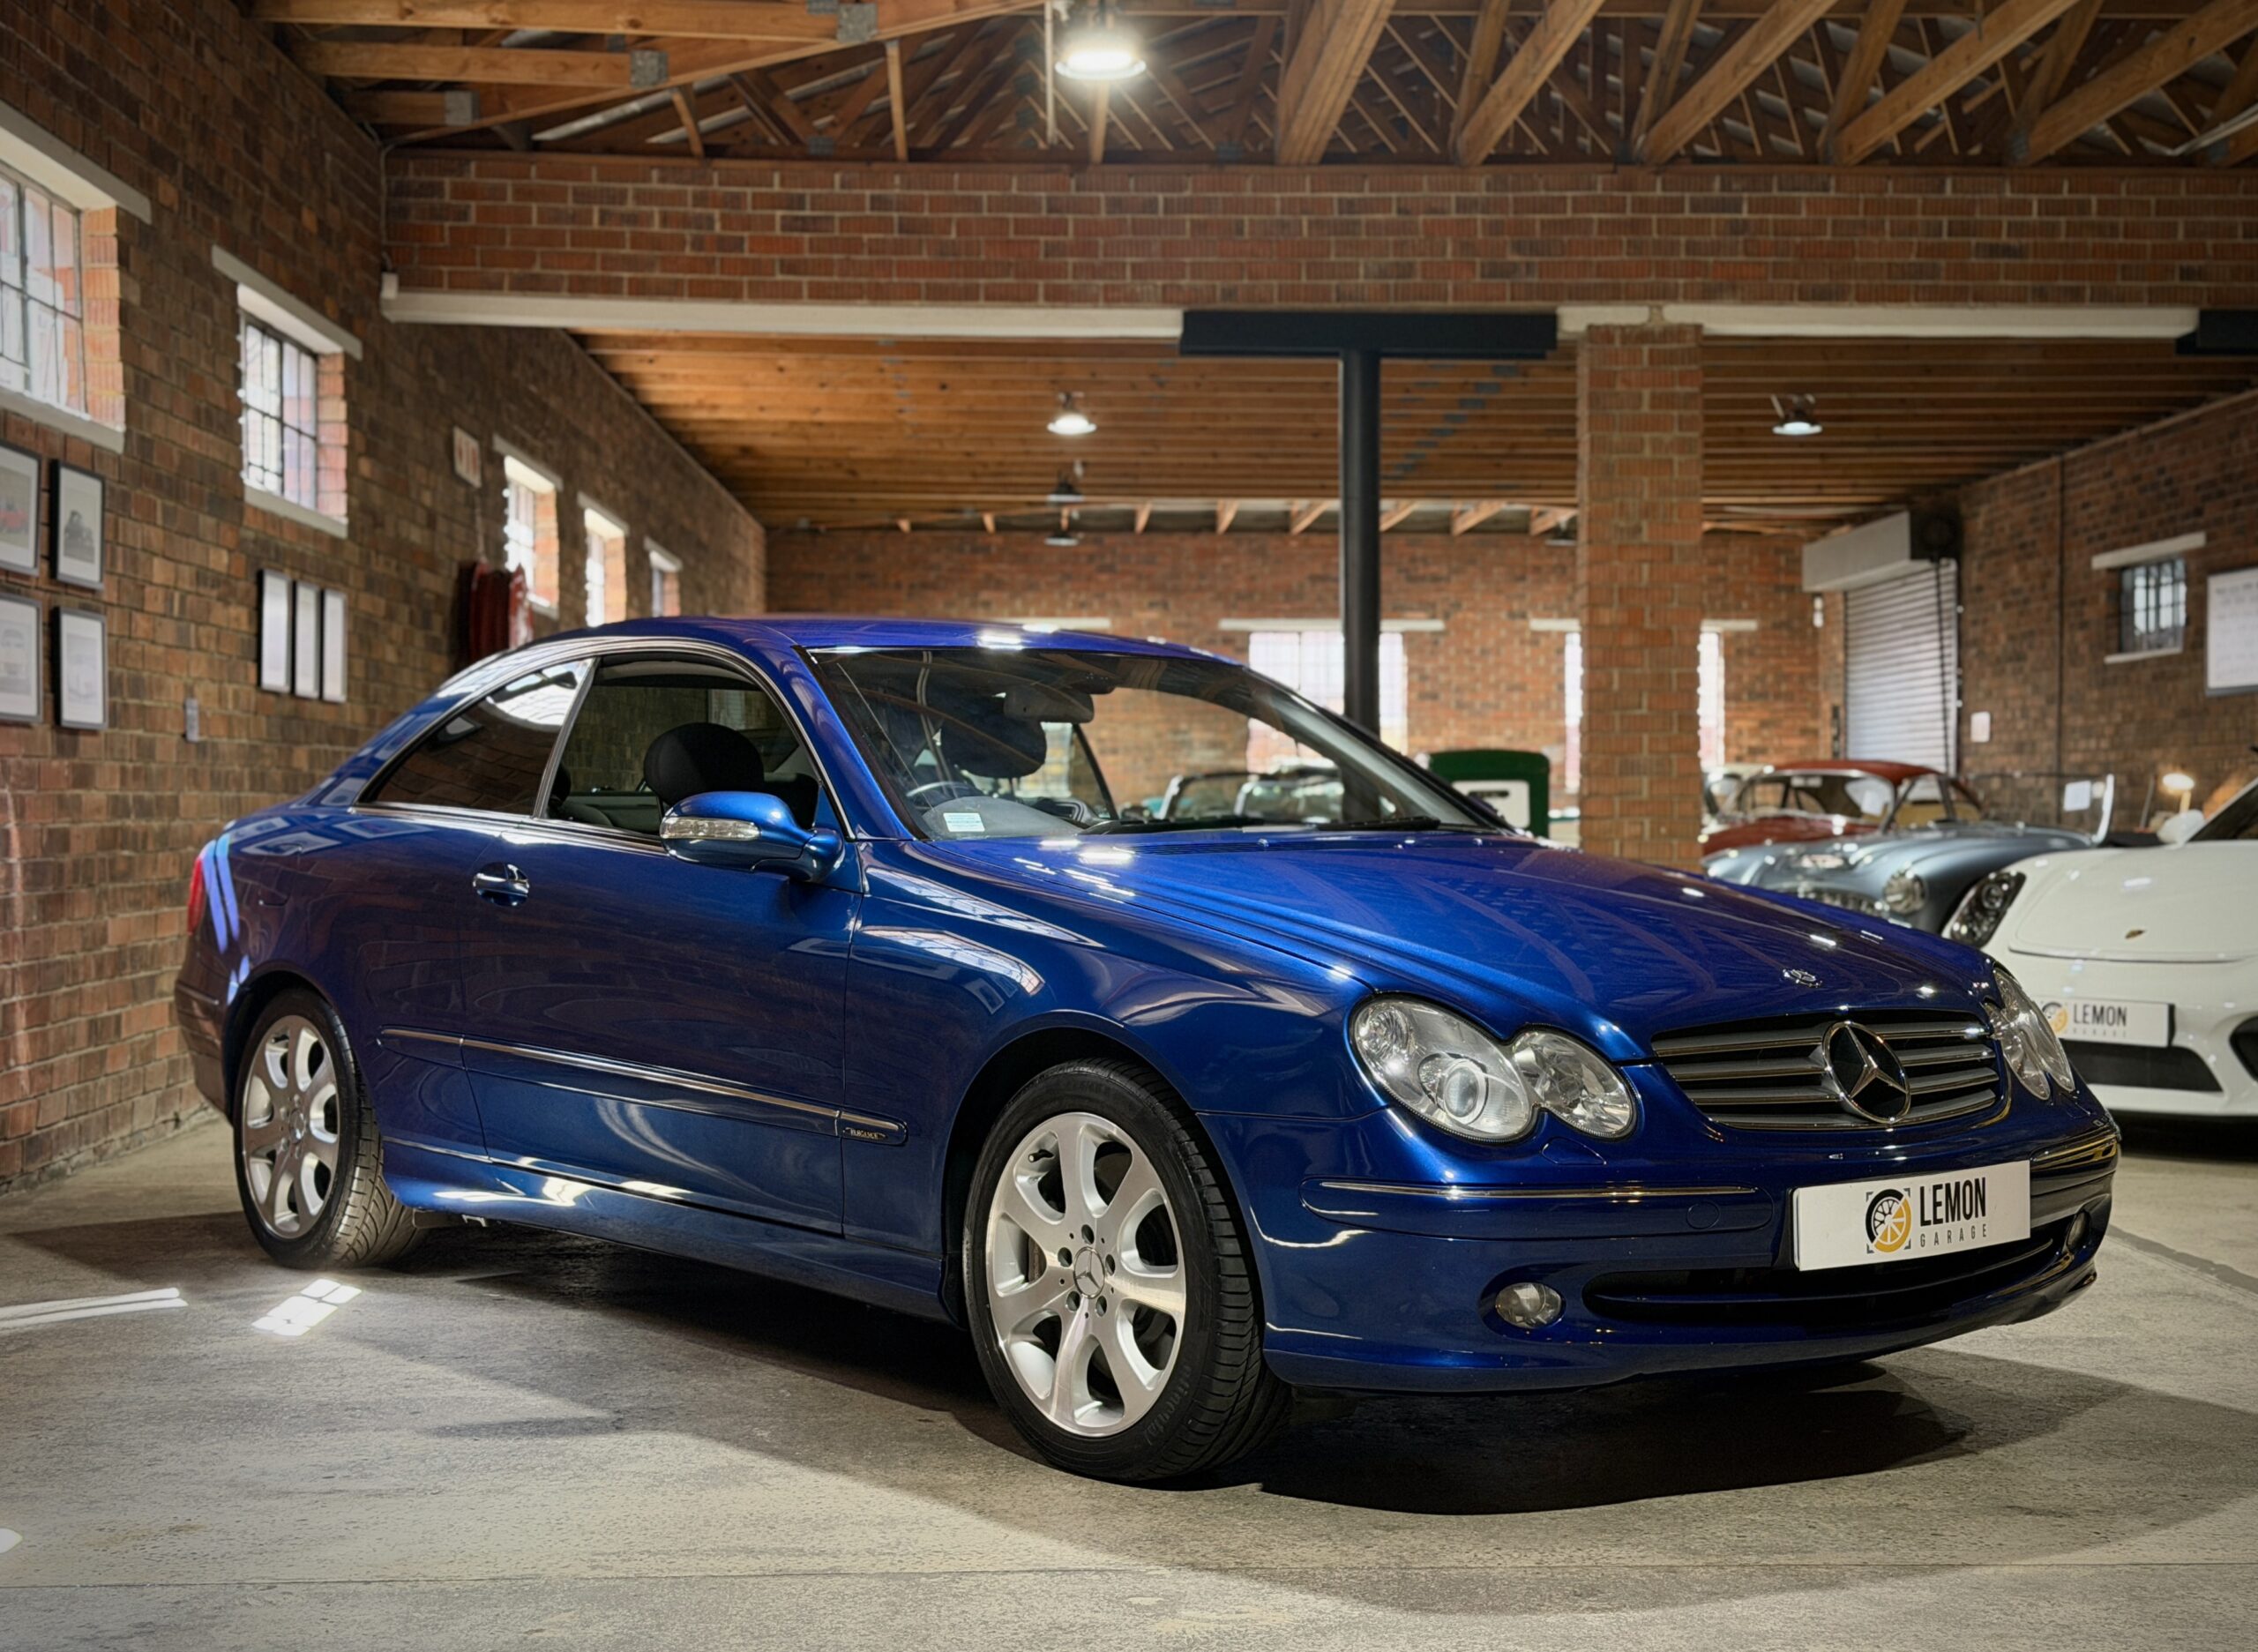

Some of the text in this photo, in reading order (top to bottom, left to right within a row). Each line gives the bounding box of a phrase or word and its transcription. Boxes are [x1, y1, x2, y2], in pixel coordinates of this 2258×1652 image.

[2074, 1004, 2127, 1027] LEMON
[1920, 1177, 1985, 1227] LEMON
[1920, 1223, 1986, 1247] GARAGE
